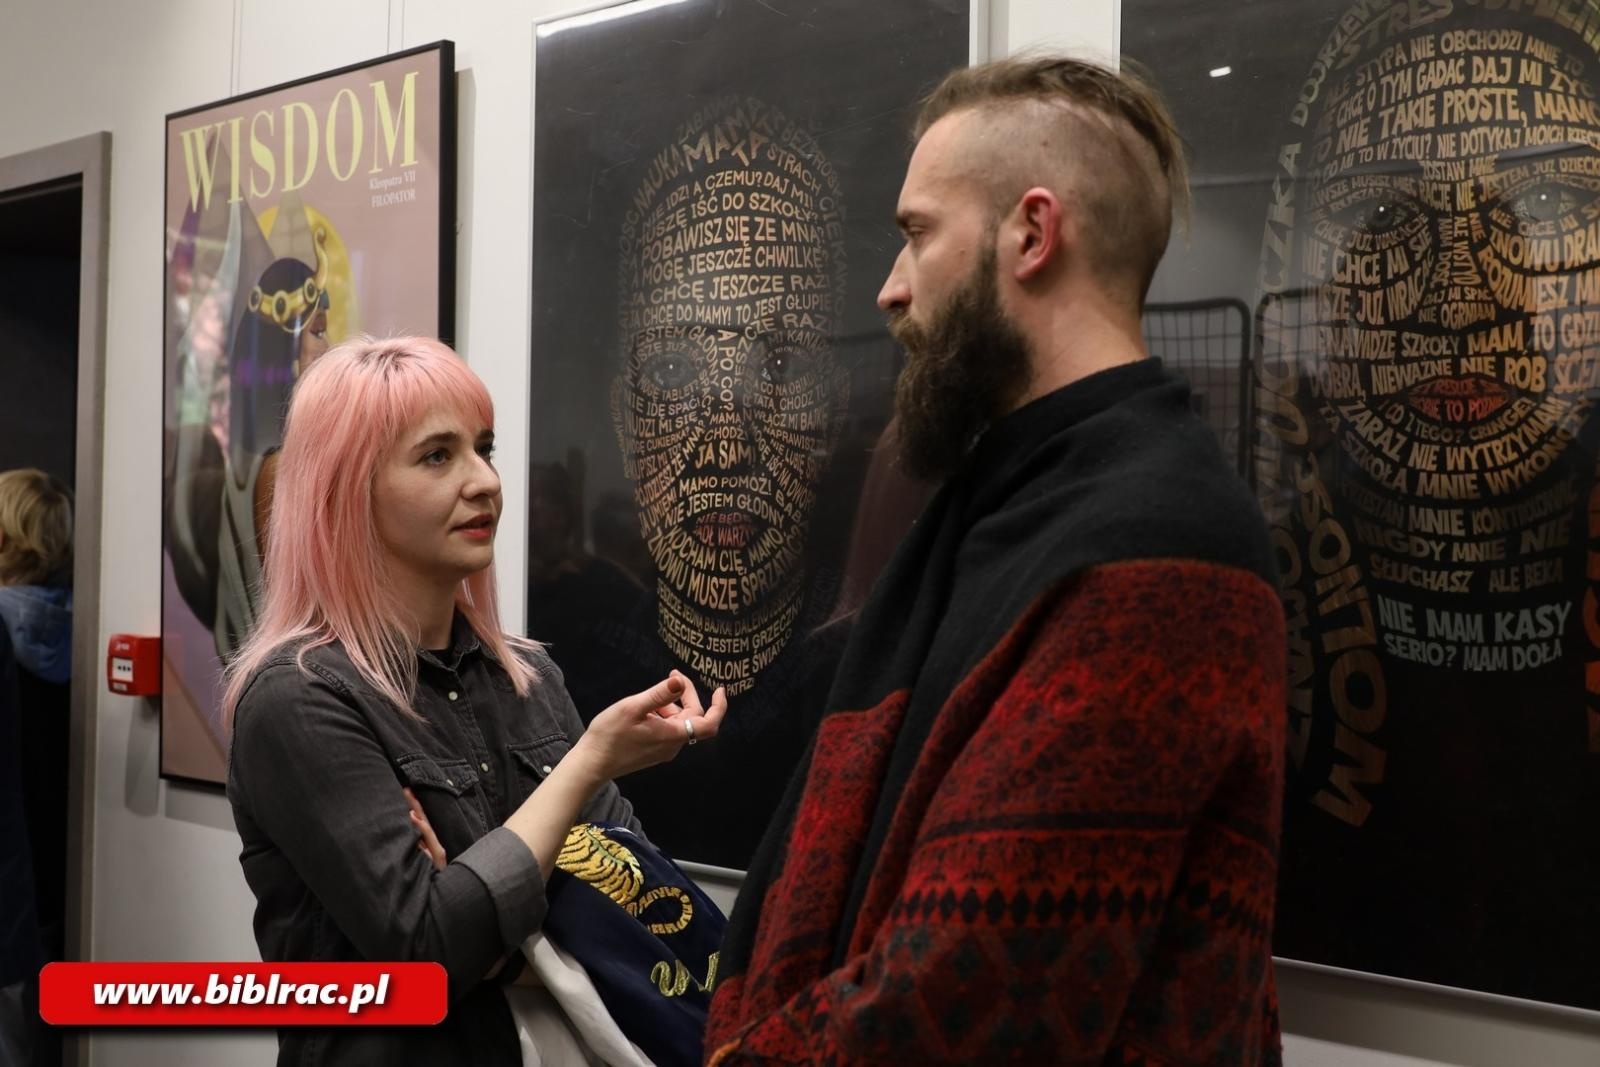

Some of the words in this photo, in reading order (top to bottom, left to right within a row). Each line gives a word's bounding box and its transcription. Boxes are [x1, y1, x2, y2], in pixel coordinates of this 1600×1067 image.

[1355, 42, 1408, 88] STYPA
[1410, 34, 1436, 62] NIE
[1440, 29, 1523, 55] OBCHODZI
[1523, 35, 1560, 66] MNIE
[1366, 81, 1377, 112] O
[1378, 67, 1413, 108] TYM
[1415, 52, 1467, 95] GADAĆ
[1471, 55, 1513, 85] DAJ
[1518, 58, 1543, 87] MI
[180, 72, 418, 212] WISDOM
[1336, 117, 1371, 156] NIE
[1379, 94, 1437, 141] TAKIE
[1358, 145, 1375, 164] TO
[1376, 141, 1390, 161] W
[1436, 133, 1457, 159] NIE
[1459, 126, 1522, 157] DOTYKAJ
[1523, 124, 1565, 147] MOICH
[763, 171, 789, 195] DAJ
[767, 143, 822, 197] STRACH
[1455, 180, 1476, 212] NIE
[1478, 165, 1530, 203] JESTEM
[690, 189, 719, 219] IŚĆ
[722, 192, 745, 211] DO
[640, 216, 723, 268] POBAWISZ
[725, 215, 751, 247] SIĘ
[754, 216, 778, 241] ZE
[1453, 216, 1470, 238] ALE
[1468, 211, 1487, 243] NIE
[641, 256, 685, 288] MOGĘ
[687, 246, 753, 276] JESZCZE
[1386, 244, 1411, 280] MI
[1488, 223, 1561, 273] ZNOWU
[650, 279, 705, 305] CHCĘ
[708, 274, 786, 303] JESZCZE
[1448, 285, 1462, 302] MI
[676, 304, 693, 322] DO
[735, 303, 751, 325] TO
[753, 295, 783, 320] JEST
[1418, 305, 1438, 324] NIE
[1400, 330, 1460, 358] SZKOŁY
[1466, 319, 1526, 357] MAM
[1529, 312, 1557, 354] TO
[760, 381, 774, 396] CO
[1369, 356, 1453, 397] NIEWAŻNE
[1458, 353, 1498, 379] NIE
[1502, 347, 1548, 393] RÓB
[658, 419, 674, 435] MI
[1383, 401, 1406, 426] CO
[1442, 399, 1465, 422] TO
[1337, 399, 1409, 463] ZARAZ
[1407, 440, 1441, 472] NIE
[694, 442, 716, 470] JA
[1340, 429, 1409, 495] SZKOŁA
[1415, 471, 1482, 500] MNIE
[679, 475, 718, 498] MAMO
[666, 501, 687, 531] NIE
[686, 492, 735, 518] JESTEM
[736, 493, 785, 530] GŁODNY
[1407, 504, 1467, 537] MNIE
[664, 524, 717, 572] KOCHAM
[1351, 510, 1447, 562] NIGDY
[1450, 538, 1507, 564] MNIE
[1518, 511, 1575, 556] NIE
[686, 566, 740, 615] MUSZĘ
[1369, 550, 1475, 593] SŁUCHASZ
[1487, 566, 1521, 593] ALE
[1523, 556, 1565, 590] BEKA
[1376, 592, 1417, 636] NIE
[1424, 606, 1486, 644] MAM
[1493, 599, 1573, 645] KASY
[705, 636, 750, 653] JESTEM
[1382, 631, 1458, 669] SERIO?
[1462, 644, 1509, 672] MAM
[1510, 636, 1565, 673] DOŁA
[691, 650, 751, 680] ZAPALONE
